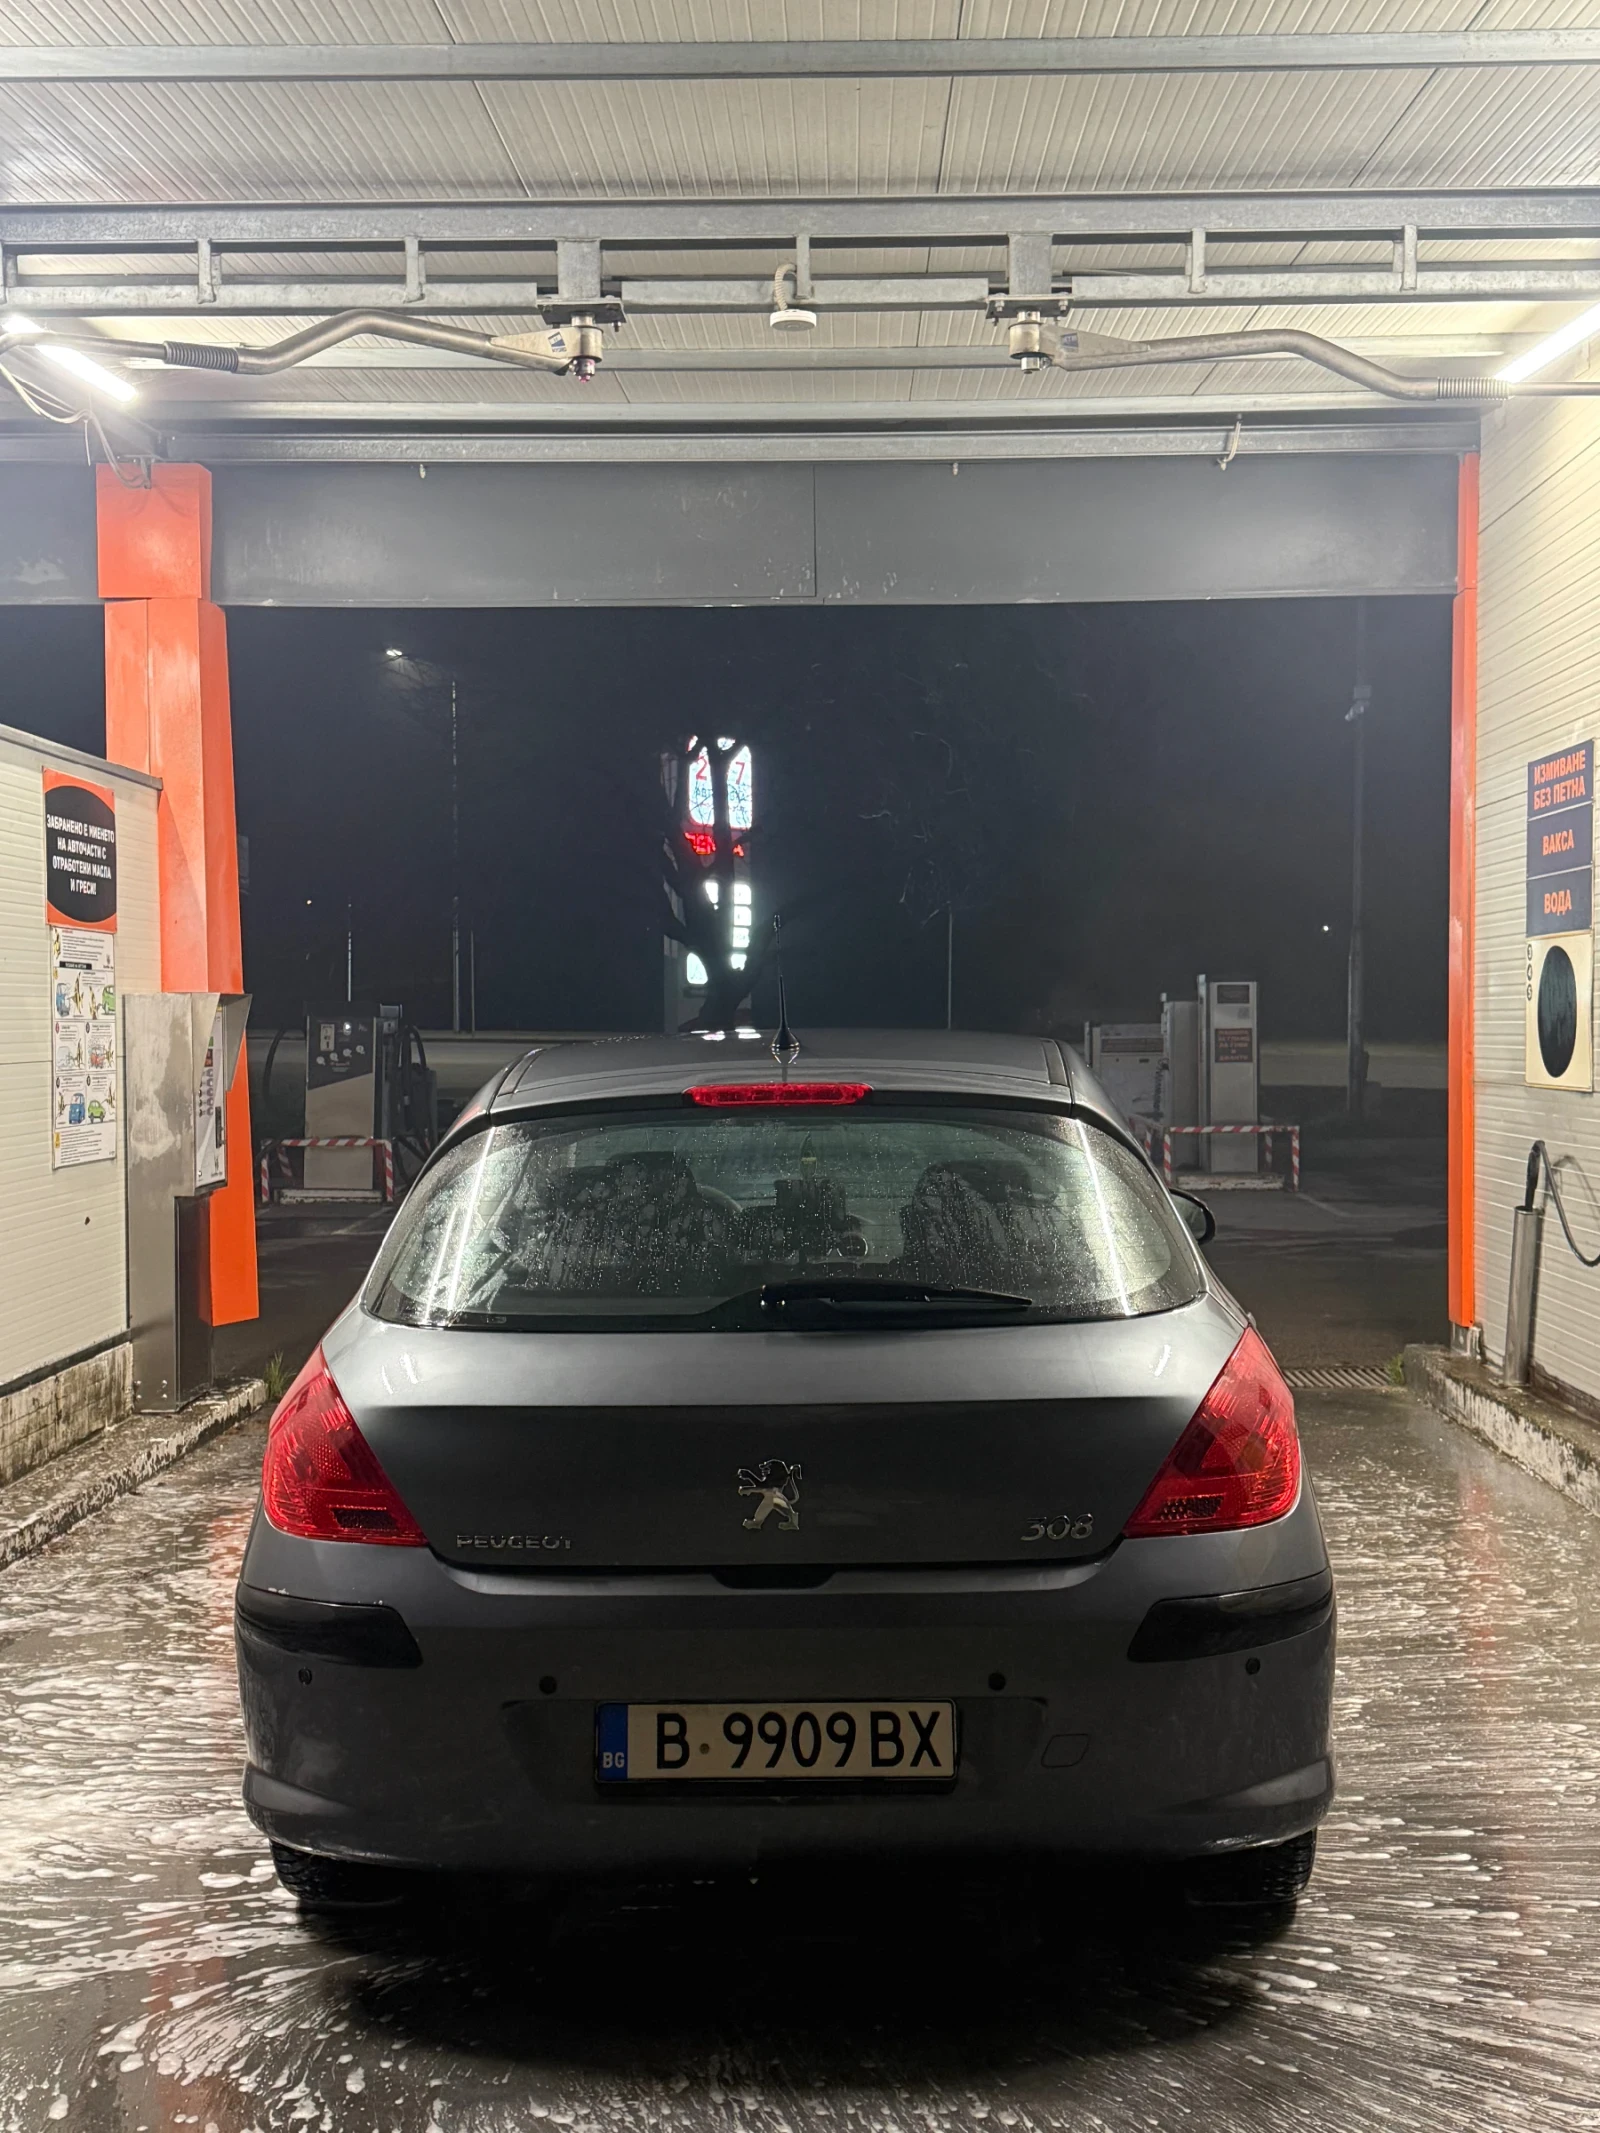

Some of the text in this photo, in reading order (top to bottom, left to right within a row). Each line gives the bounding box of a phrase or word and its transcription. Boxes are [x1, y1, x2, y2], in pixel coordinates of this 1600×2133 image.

[1534, 749, 1586, 786] ИЗМИВАНЕ
[1533, 775, 1586, 811] БЕЗ ПЕТНА
[46, 813, 115, 843] ЗАБРАНЕНО Е МИЕНЕТО
[57, 836, 107, 860] НА АВТОЧАСТИ С
[1542, 829, 1574, 856] ВАКСА
[52, 855, 112, 879] ОТРАБОТЕНИ МАСЛА
[70, 878, 75, 892] И
[1543, 889, 1572, 916] ВОДА
[1020, 1513, 1094, 1541] 308
[456, 1534, 572, 1550] PEUGEOT
[656, 1710, 942, 1770] B 9909 BX
[602, 1751, 625, 1769] BG
